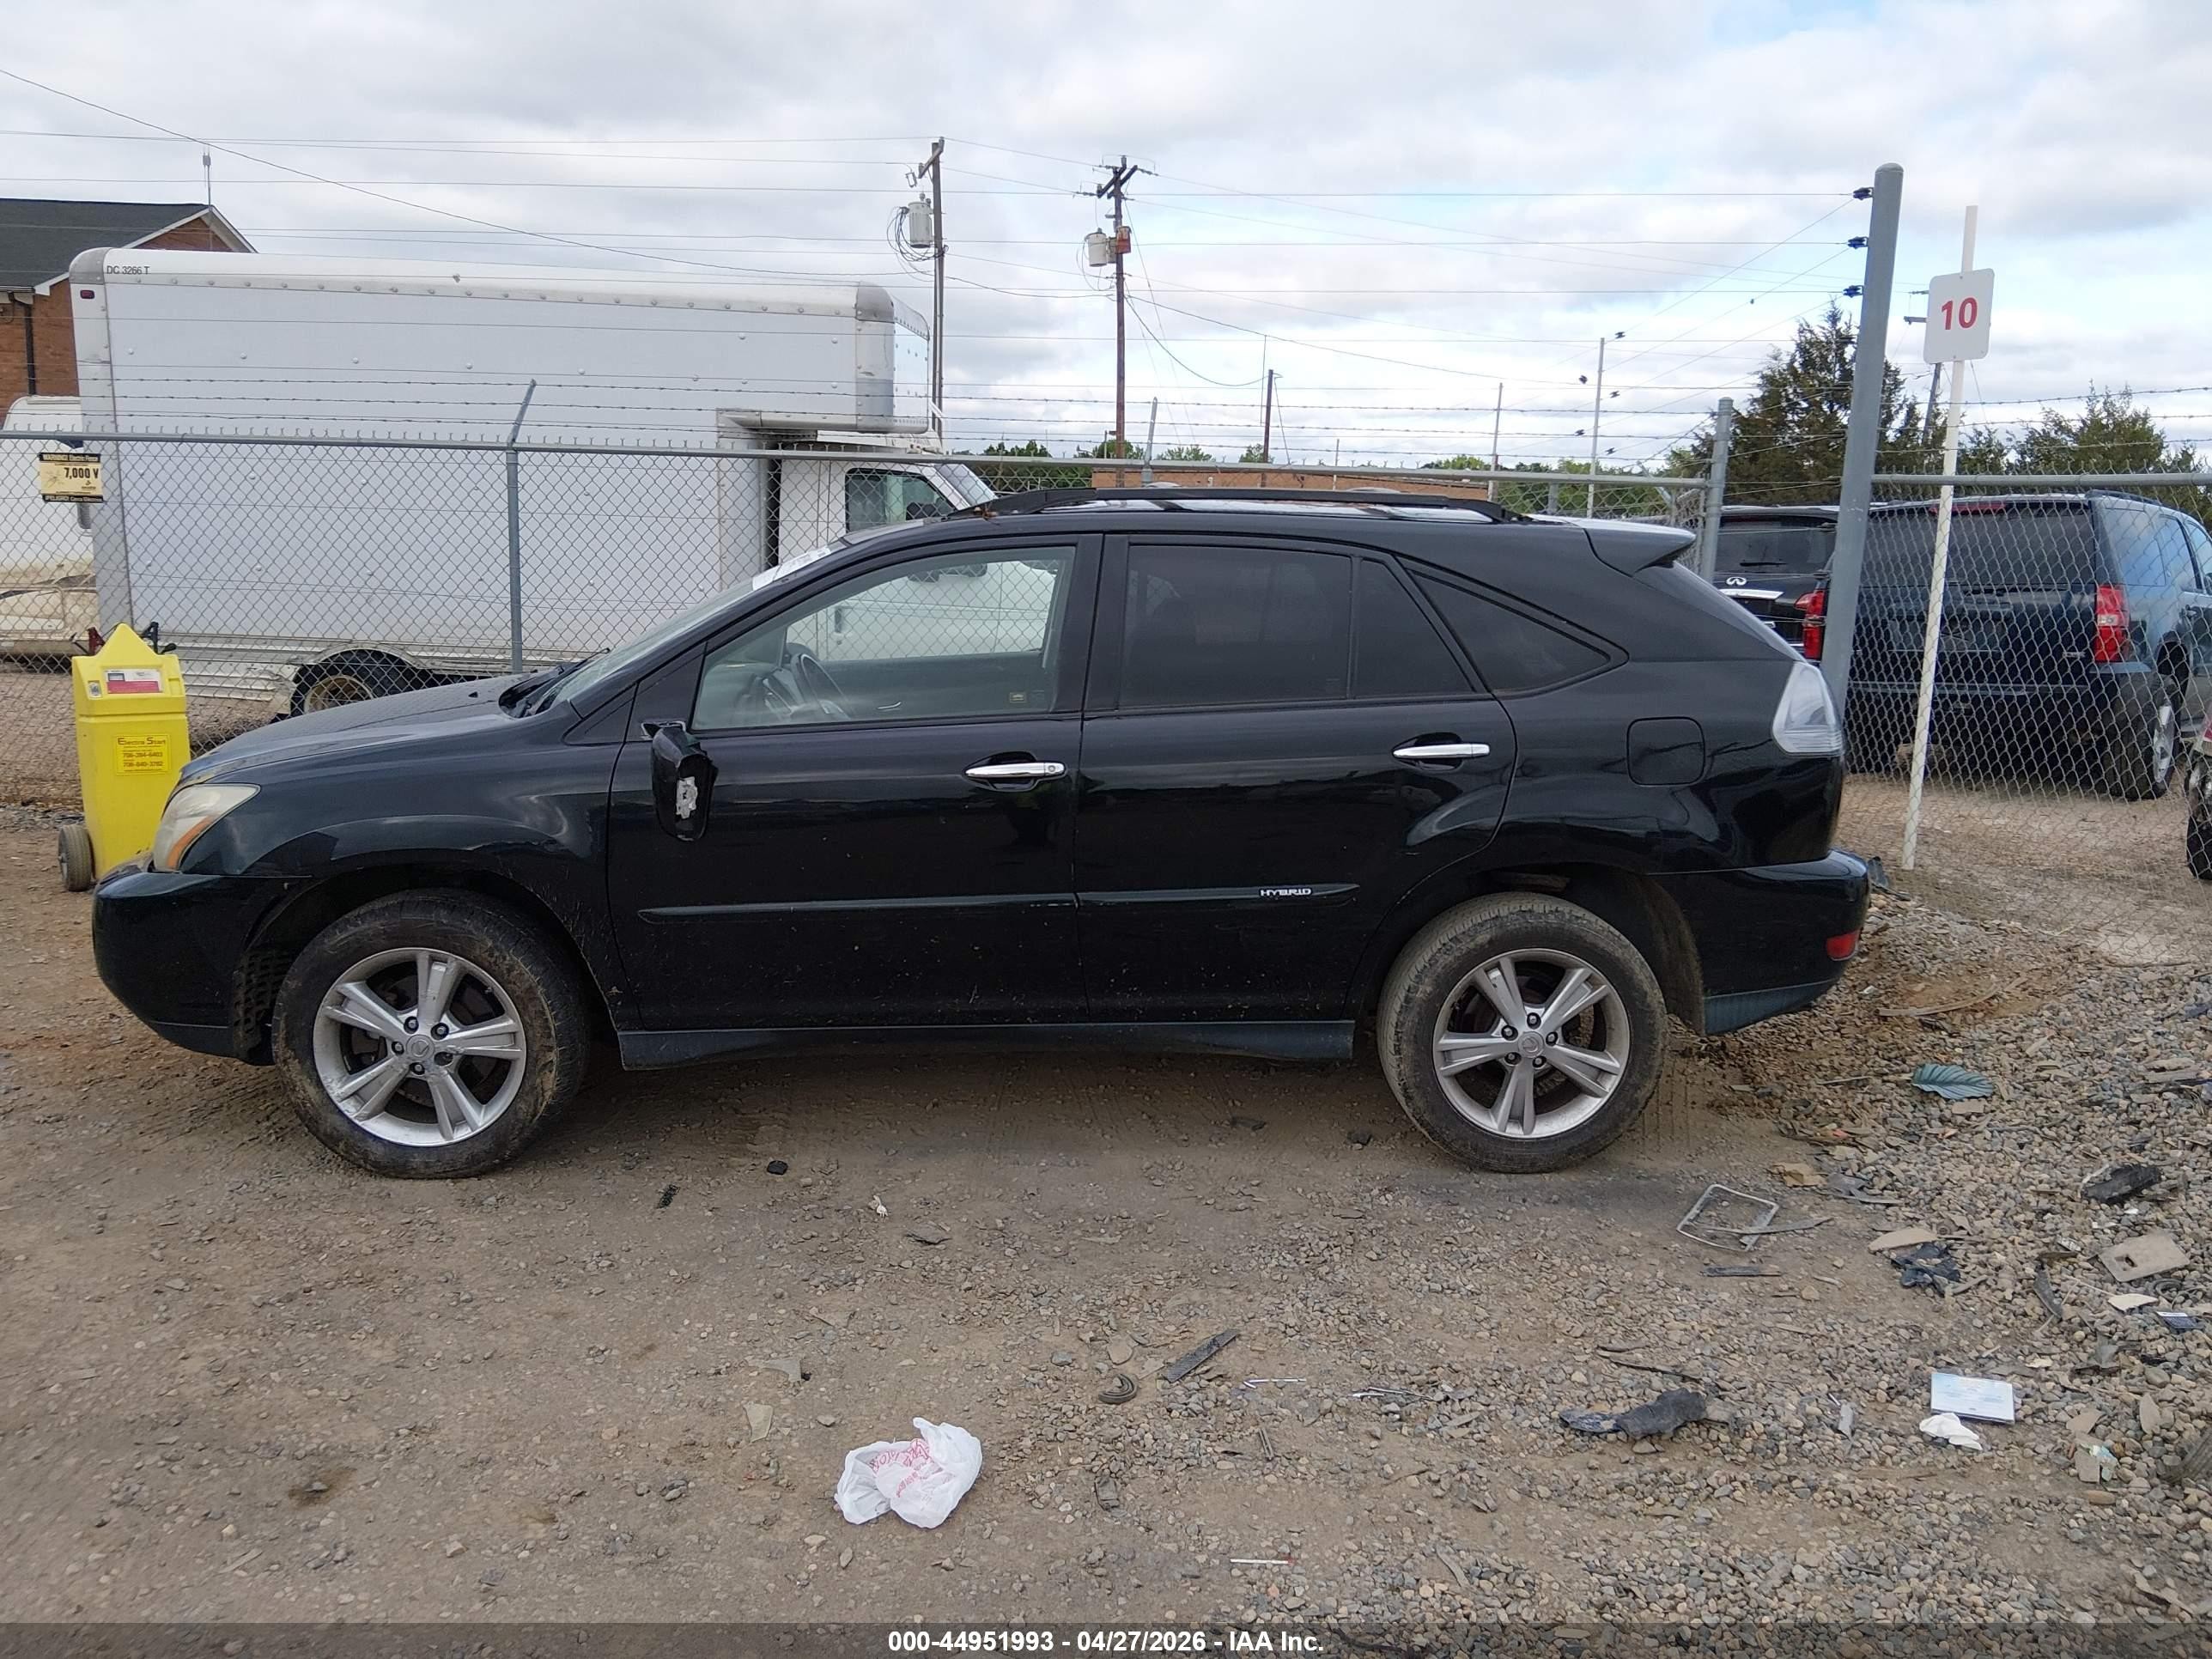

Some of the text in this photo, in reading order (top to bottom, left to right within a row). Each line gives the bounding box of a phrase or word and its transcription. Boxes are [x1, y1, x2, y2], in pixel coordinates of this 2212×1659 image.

[106, 265, 120, 275] DC
[143, 265, 150, 275] T
[1941, 296, 1978, 331] 10
[64, 467, 100, 479] 7,000 V
[1260, 888, 1312, 896] HYBRID
